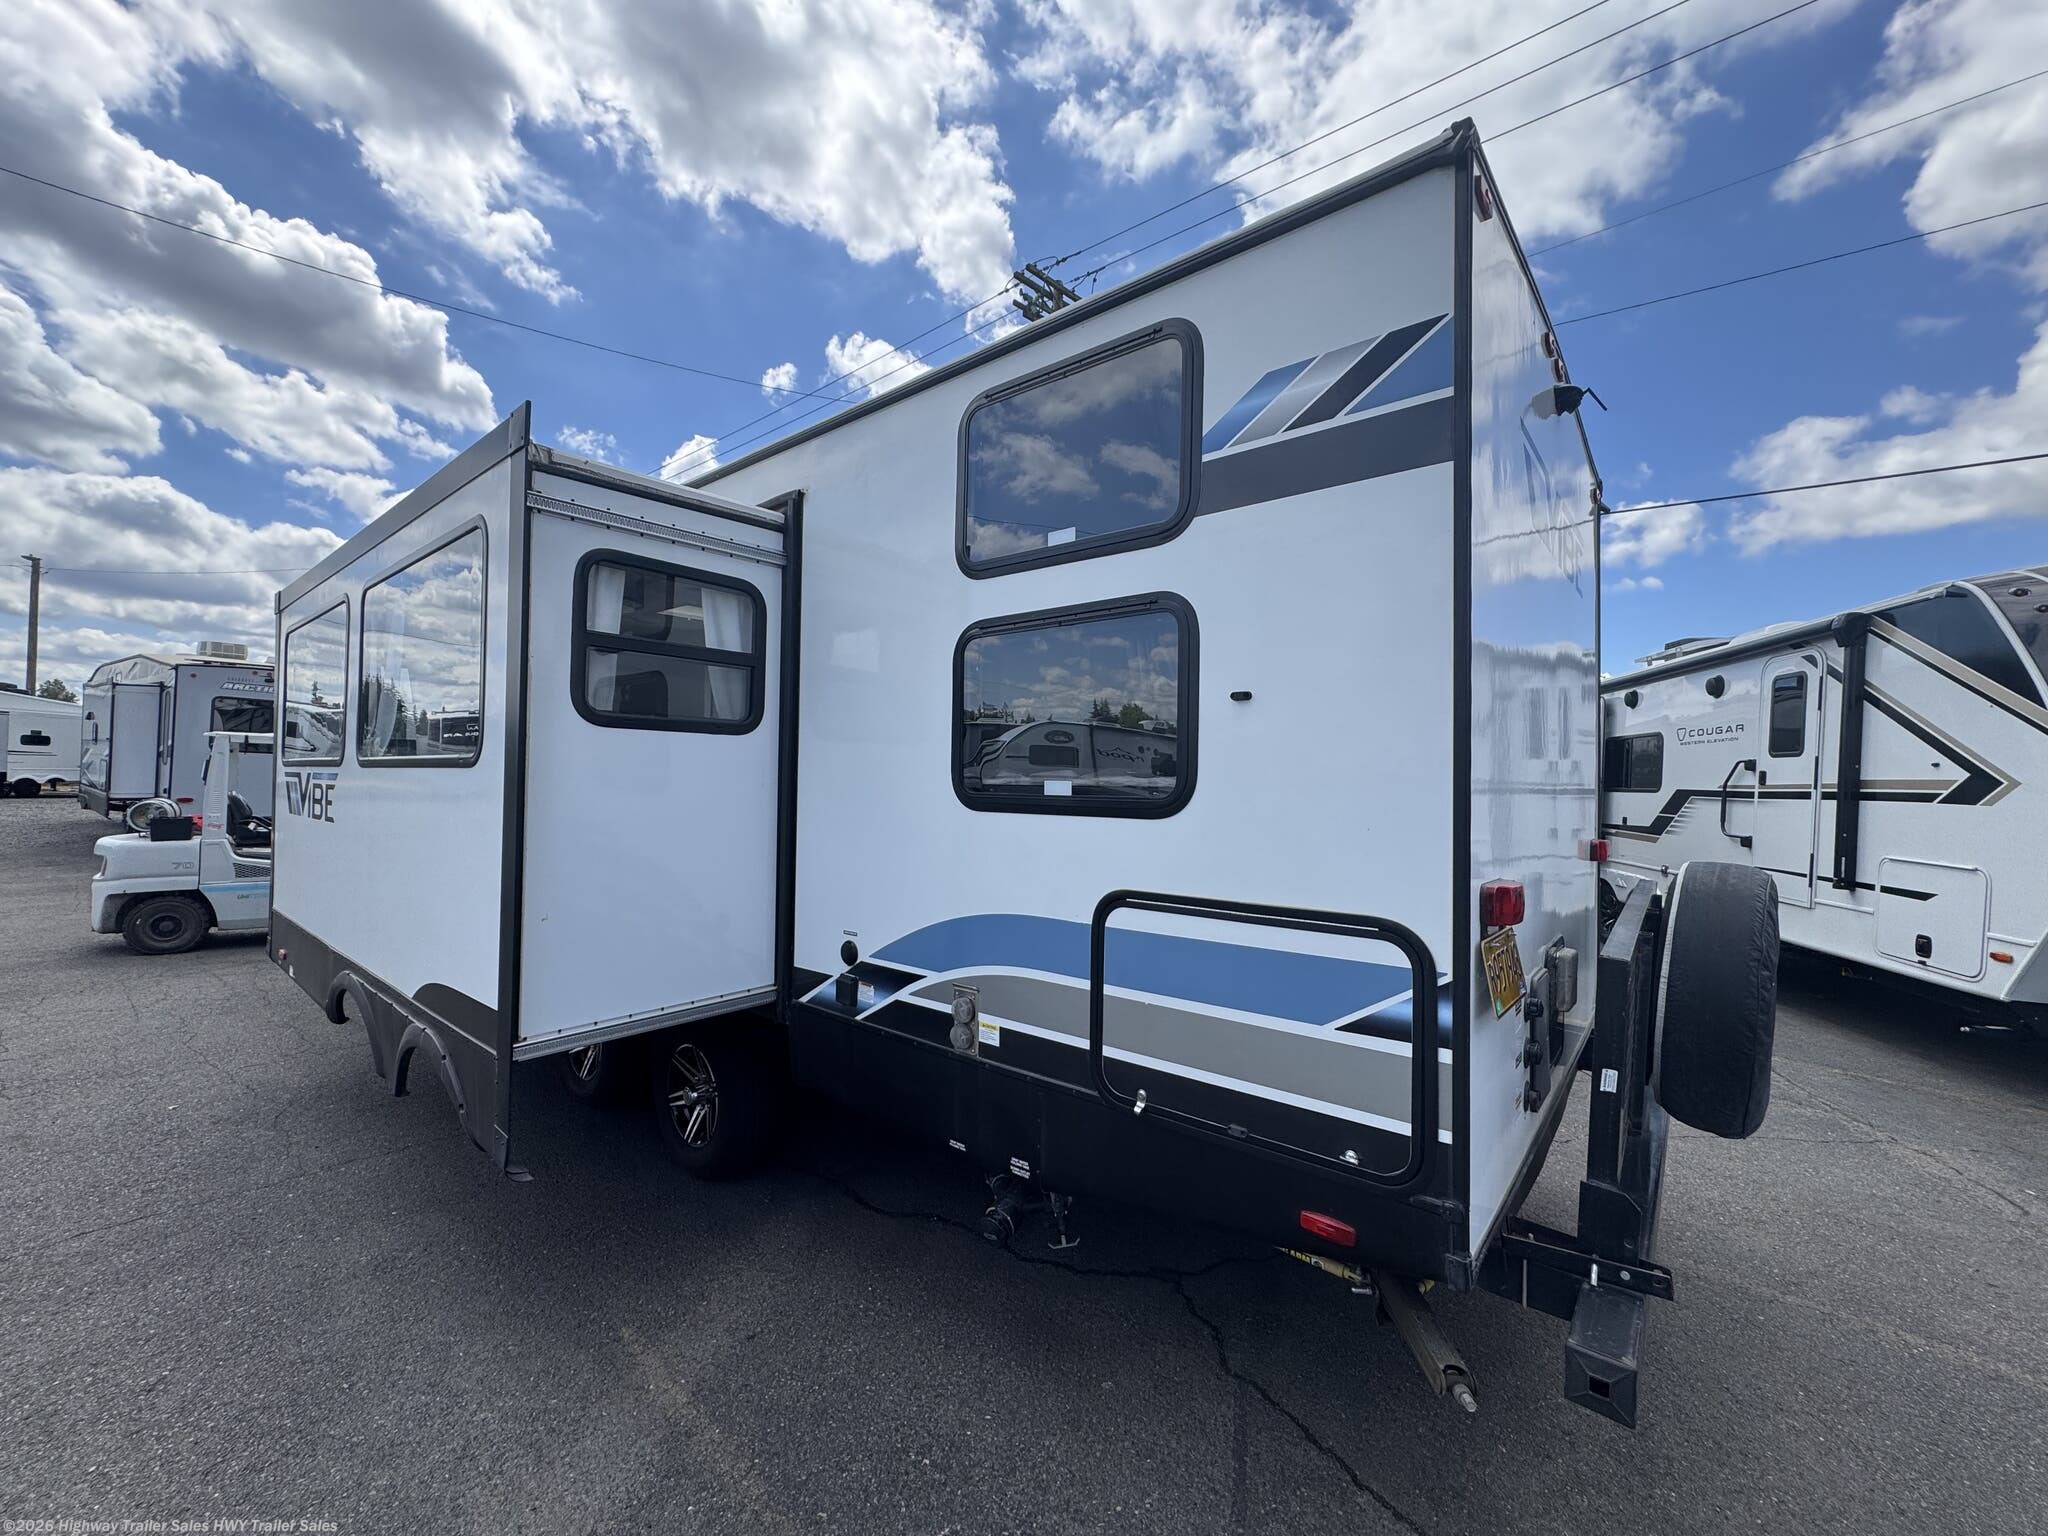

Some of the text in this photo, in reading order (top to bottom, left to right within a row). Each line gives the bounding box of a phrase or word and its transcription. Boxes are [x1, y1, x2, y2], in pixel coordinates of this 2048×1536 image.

[1688, 723, 1744, 737] COUGAR
[284, 771, 336, 823] VIBE
[172, 862, 194, 870] 70
